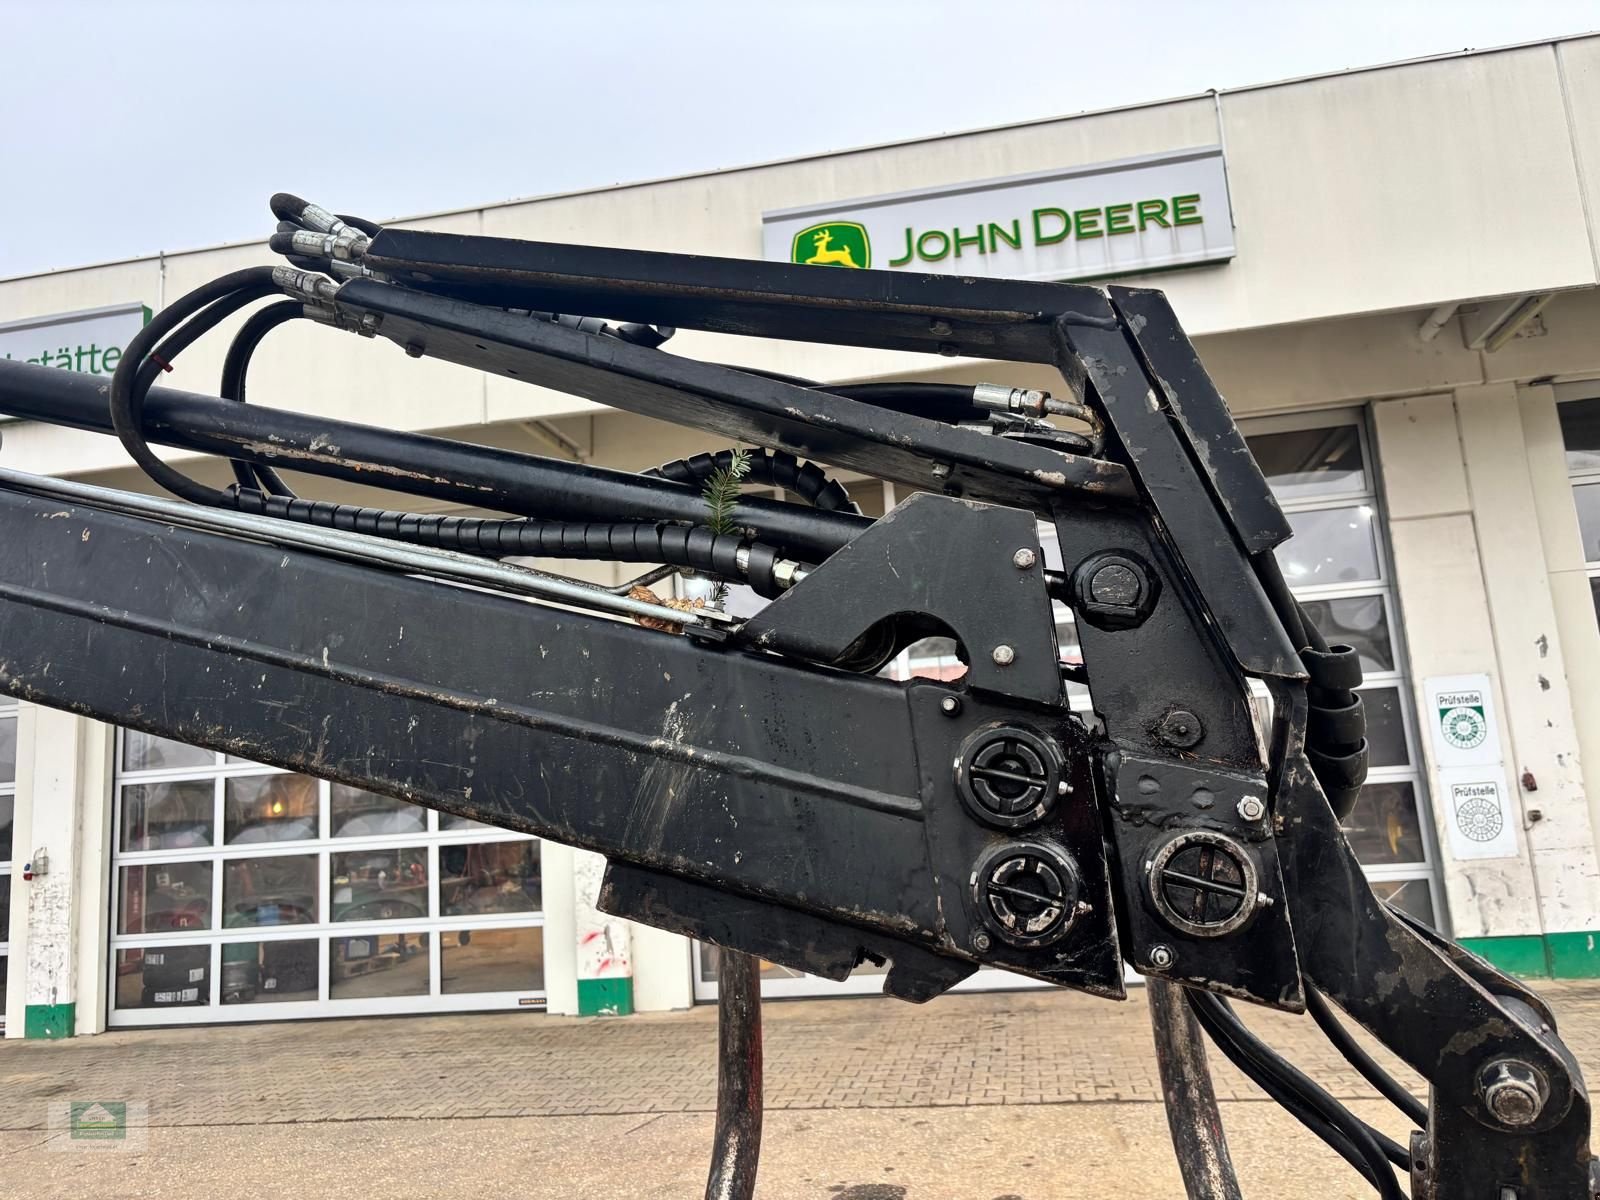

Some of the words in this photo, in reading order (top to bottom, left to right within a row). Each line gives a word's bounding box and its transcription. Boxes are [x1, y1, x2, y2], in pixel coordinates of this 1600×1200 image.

[889, 219, 1021, 267] JOHN
[1032, 194, 1203, 247] DEERE
[1439, 694, 1480, 706] Prüfstelle
[1455, 785, 1496, 797] Prüfstelle
